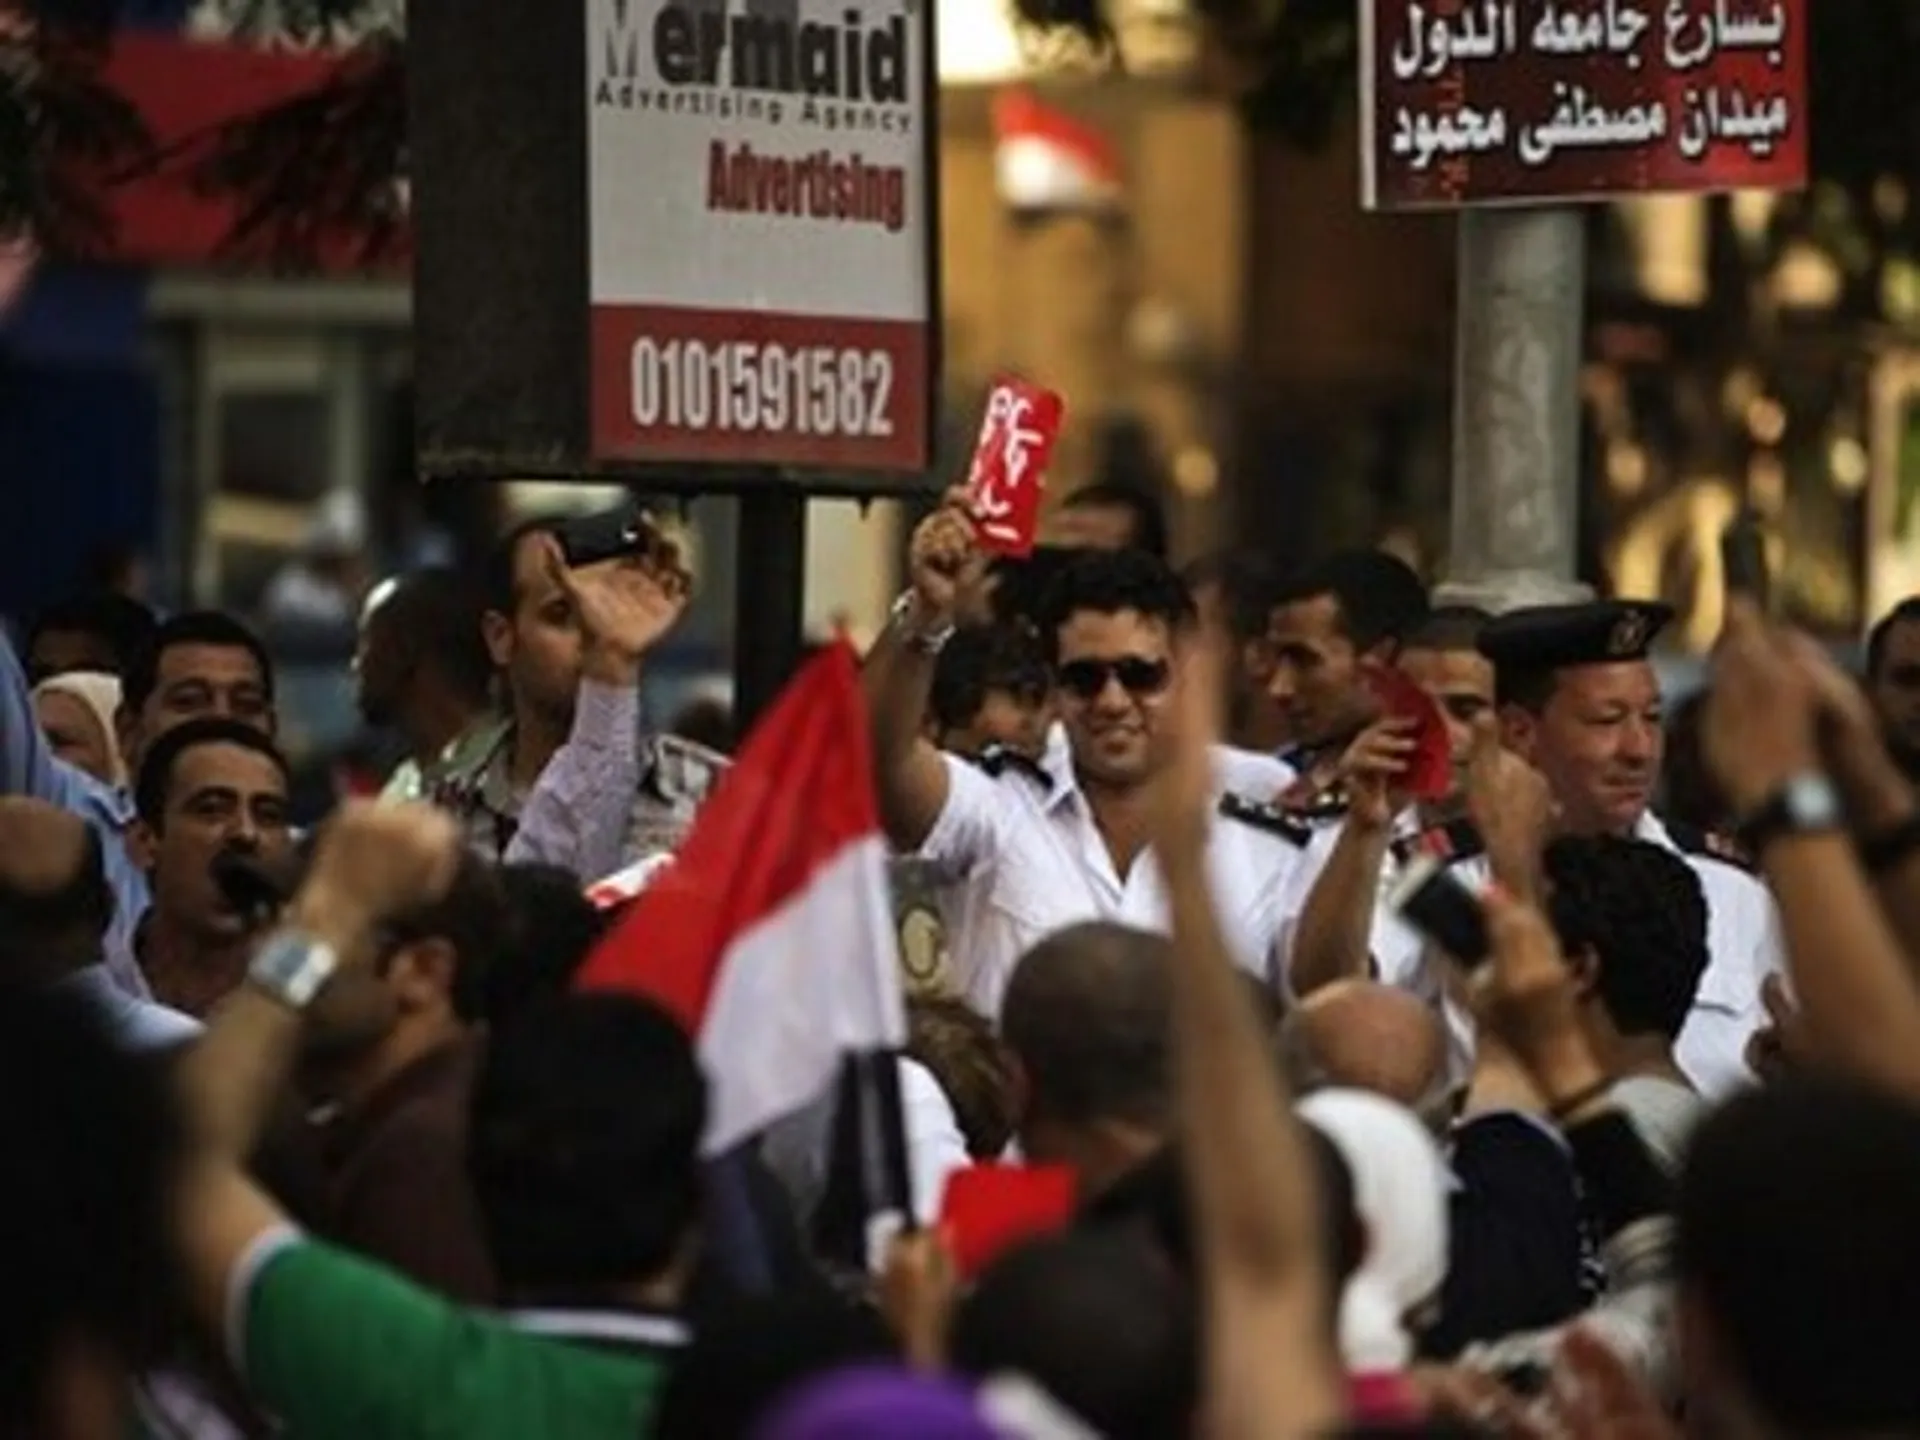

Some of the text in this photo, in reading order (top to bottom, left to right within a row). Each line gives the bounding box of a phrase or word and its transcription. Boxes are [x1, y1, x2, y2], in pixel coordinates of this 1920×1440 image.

[1393, 0, 1515, 76] الدول
[803, 101, 912, 134] Agency
[1392, 102, 1504, 167] محمود
[1679, 87, 1787, 156] ميدان
[707, 139, 905, 232] Advertising
[631, 336, 893, 436] 0101591582
